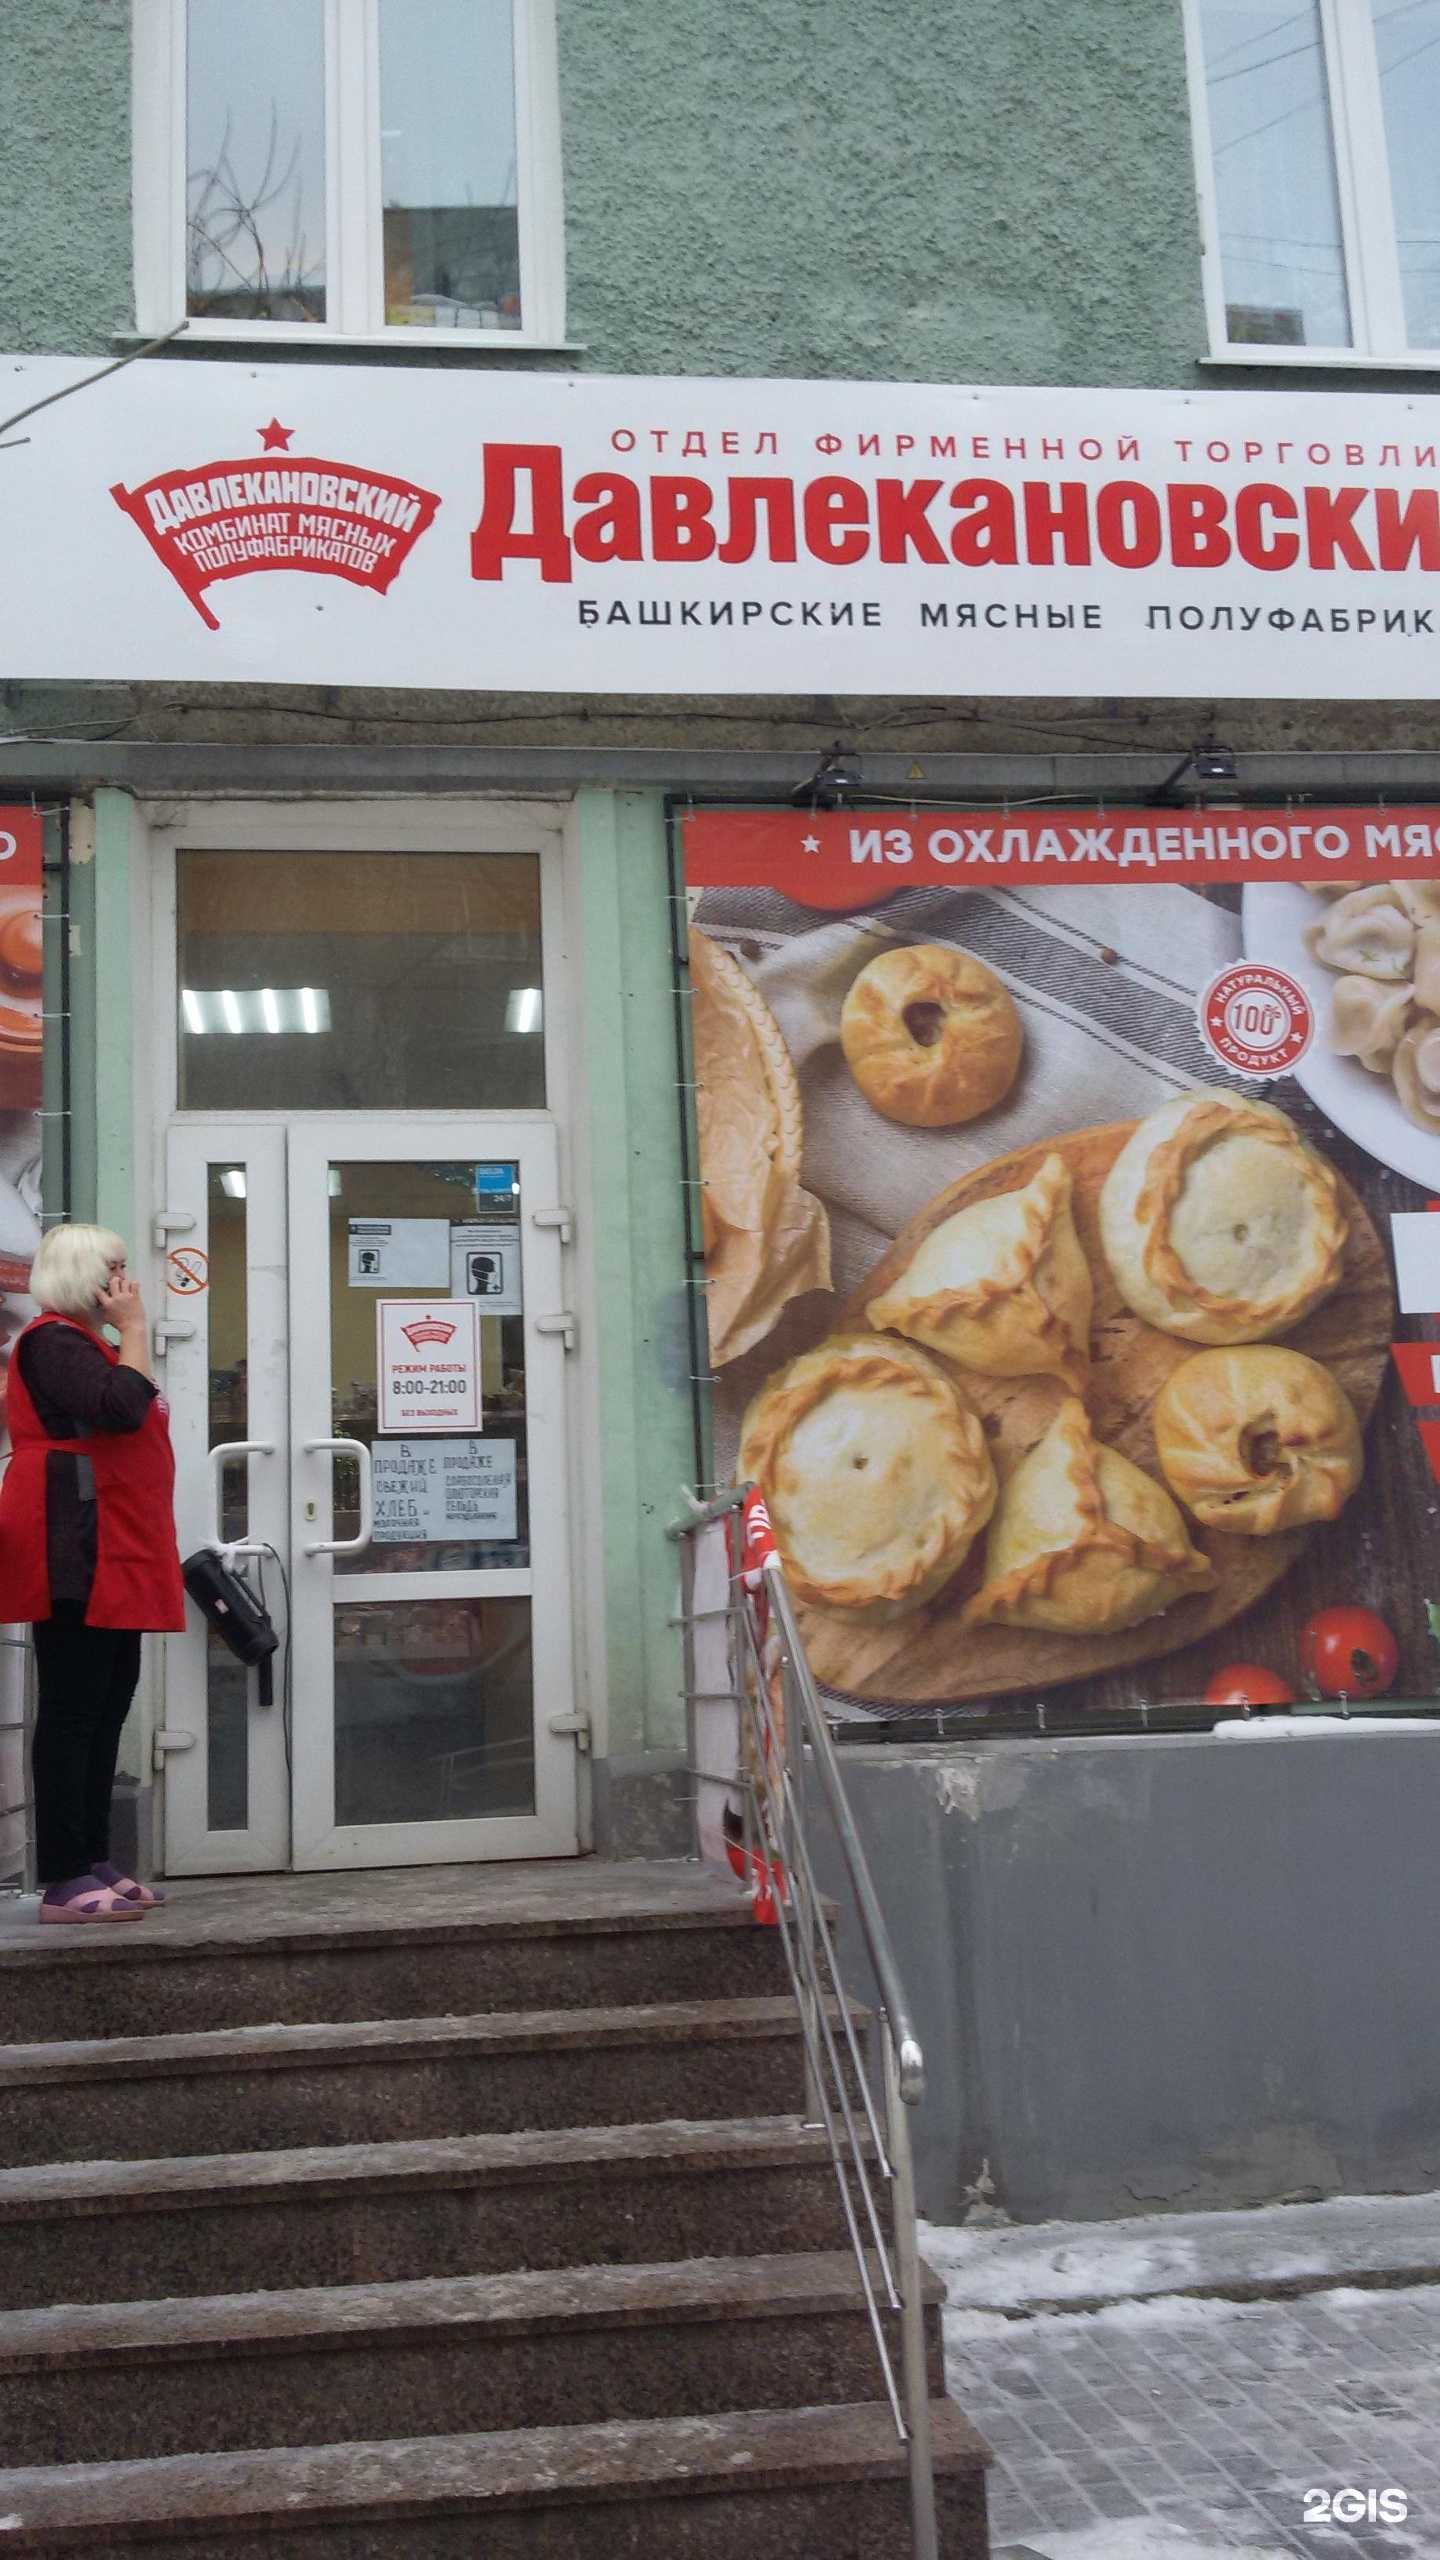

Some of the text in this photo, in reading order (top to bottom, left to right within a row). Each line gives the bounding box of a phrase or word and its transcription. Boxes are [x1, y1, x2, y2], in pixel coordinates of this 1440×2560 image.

[611, 429, 1436, 467] ОТДЕЛ ФИРМЕННОЙ ТОРГОВЛИ
[145, 471, 421, 536] ДАВЛЕКАНОВСКИЙ
[173, 512, 397, 557] КОМБИНАТ МЯСНЫХ
[192, 535, 379, 573] ПОЛУФАБРИКАТОВ
[578, 599, 882, 627] БАШКИРСКИЕ
[921, 603, 1102, 629] МЯСНЫЕ
[850, 824, 1440, 869] ИЗ ОХЛАЖДЕННОГО МЯ
[1219, 1037, 1289, 1067] ПРОДУКТ
[392, 1364, 466, 1373] РЕЖИМ РАБОТЫ
[393, 1380, 467, 1394] 8:00-21:00
[374, 1459, 438, 1475] ПРОДАЖЕ
[375, 1499, 418, 1517] ХЛЕБ
